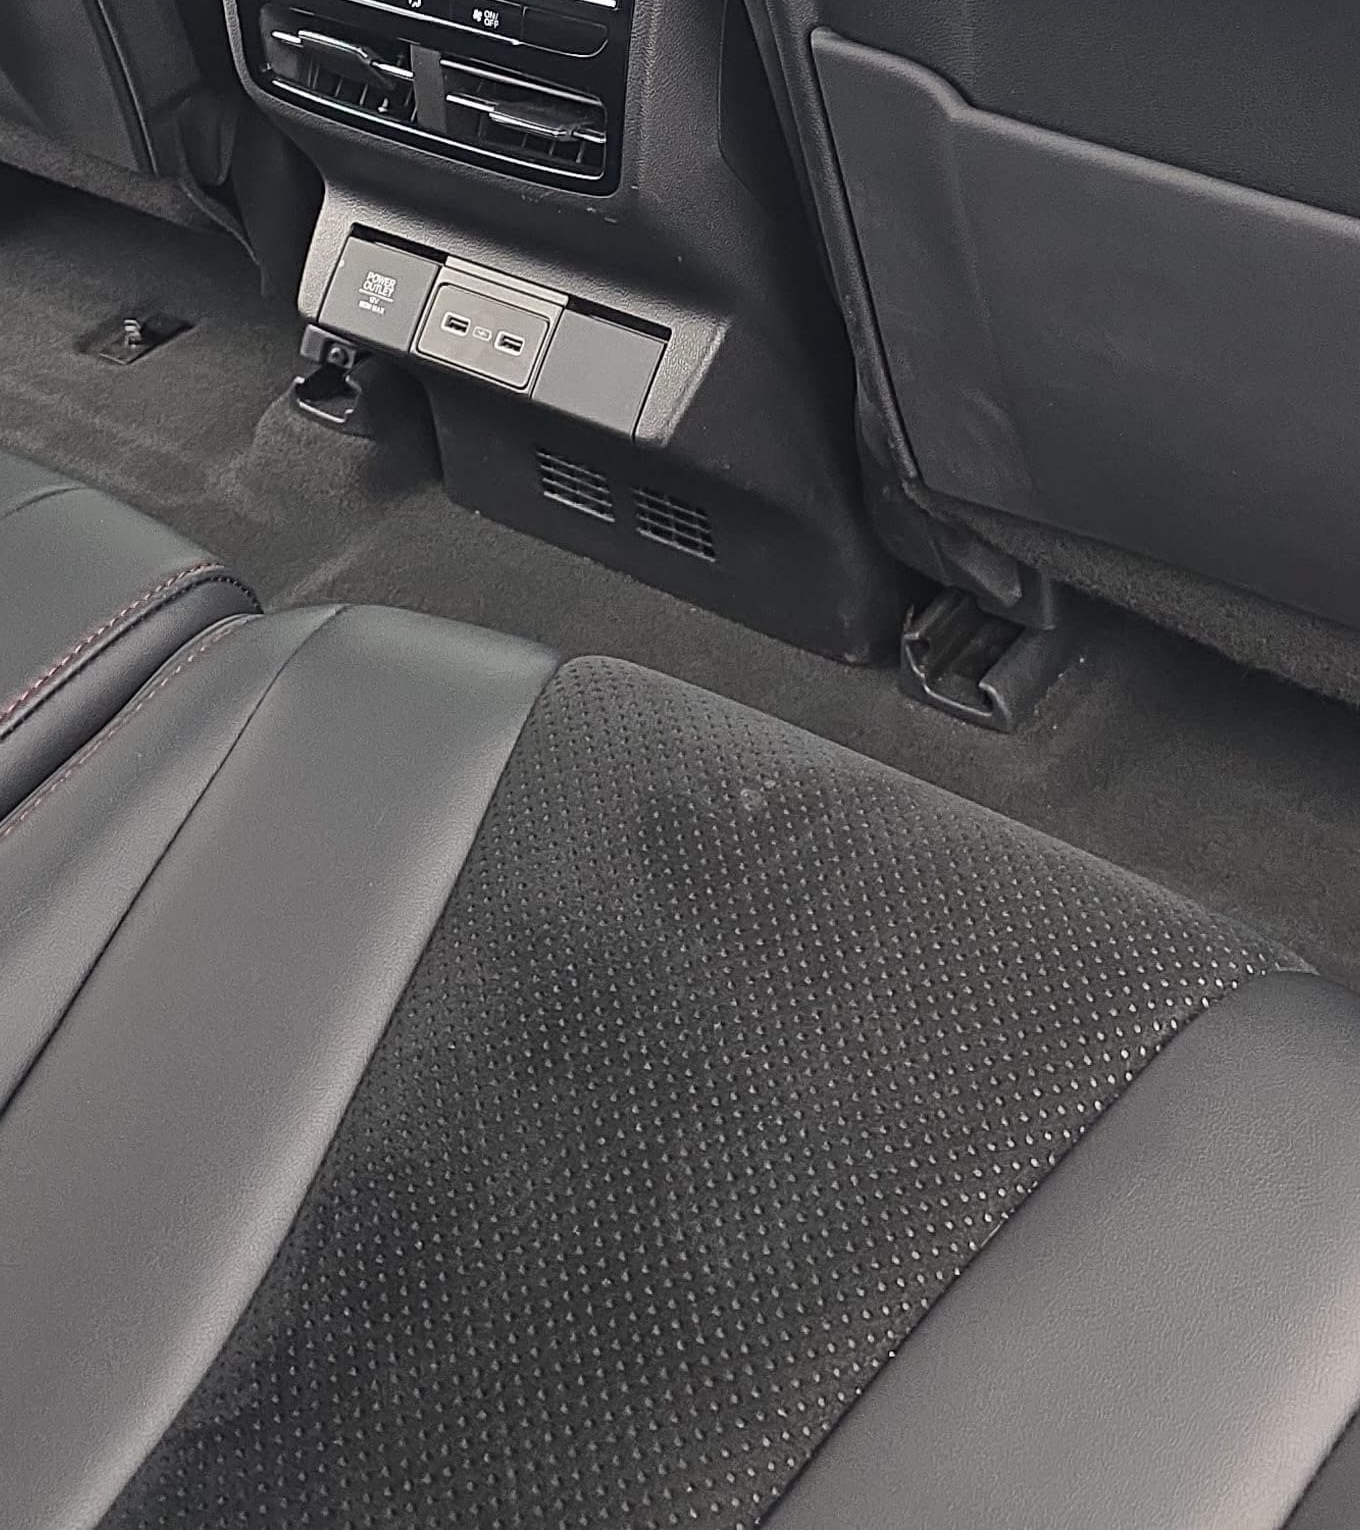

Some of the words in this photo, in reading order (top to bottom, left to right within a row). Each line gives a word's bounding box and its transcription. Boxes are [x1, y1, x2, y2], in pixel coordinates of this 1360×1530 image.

[484, 18, 499, 28] OFF
[367, 271, 396, 287] POWER
[363, 280, 394, 297] OUTLET
